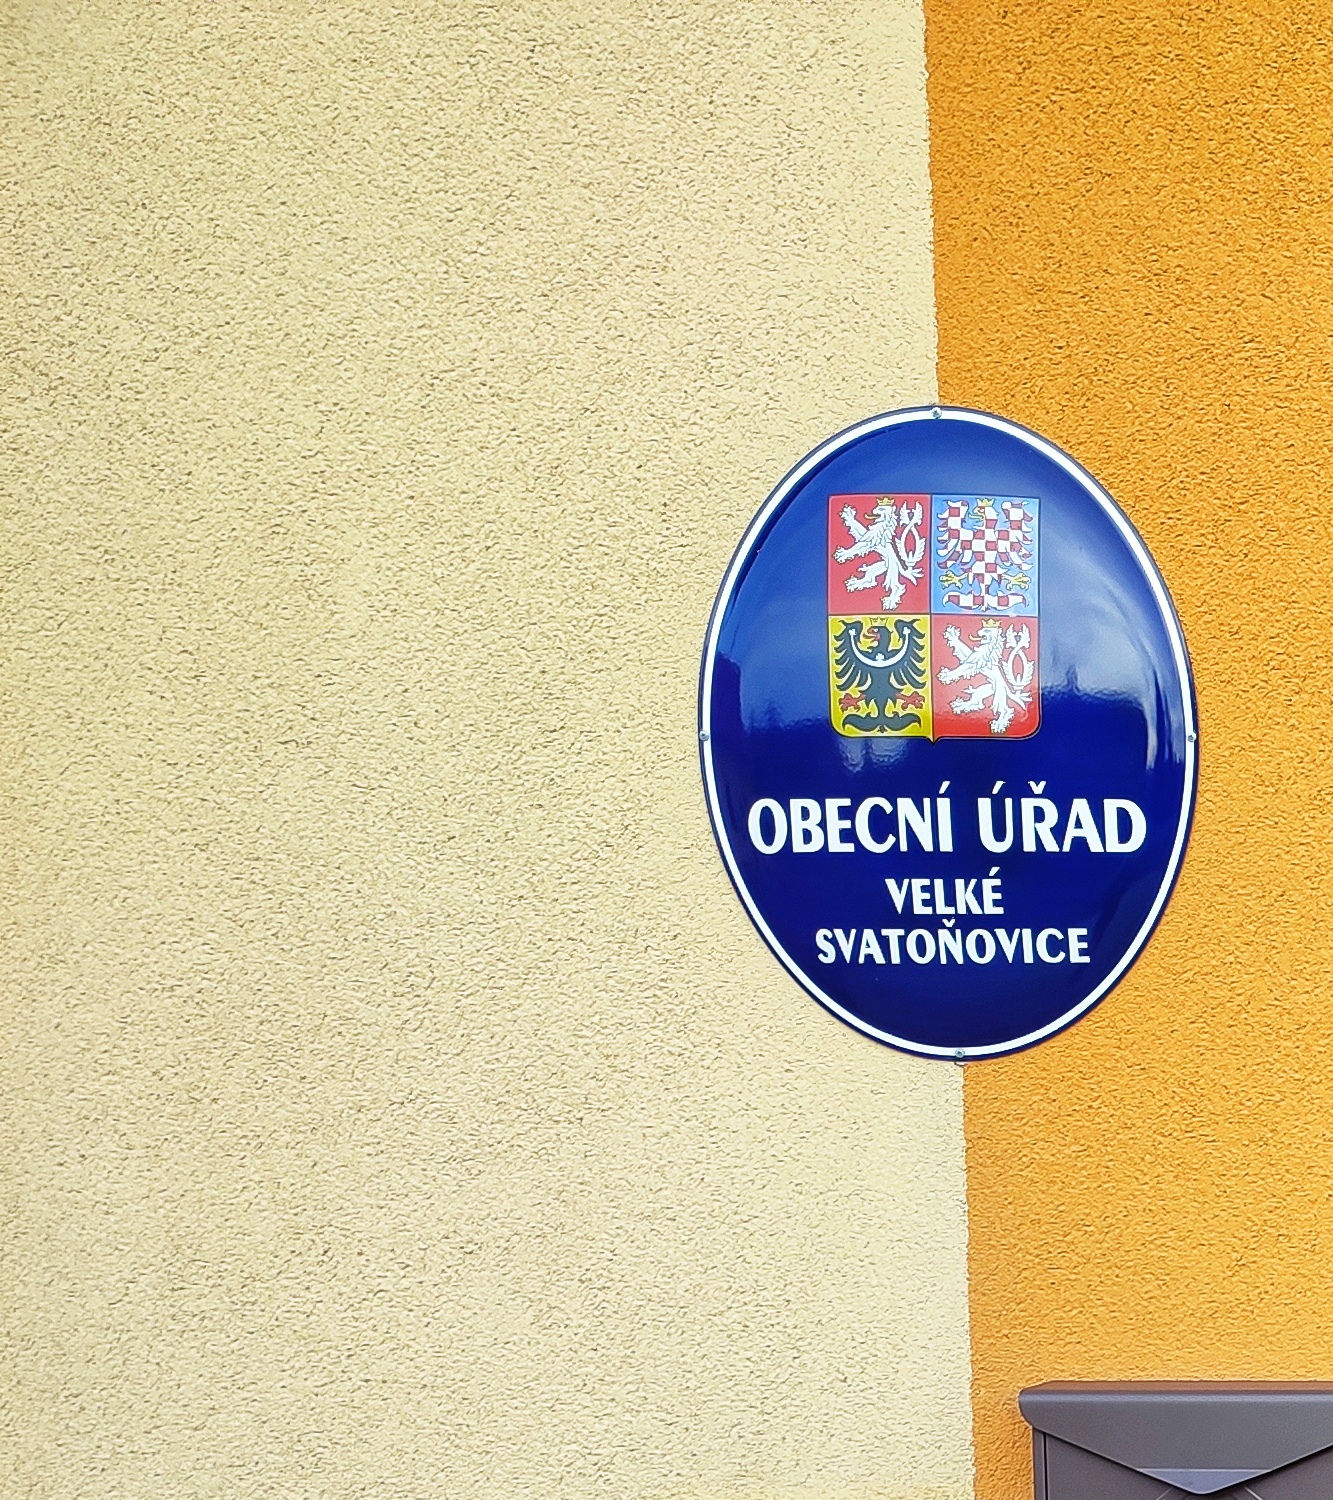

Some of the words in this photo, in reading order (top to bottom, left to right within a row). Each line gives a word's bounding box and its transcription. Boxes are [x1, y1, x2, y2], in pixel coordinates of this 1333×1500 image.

[747, 781, 954, 855] OBECNÍ
[978, 781, 1148, 854] ÚŘAD
[884, 867, 1005, 915] VELKÉ
[816, 918, 1091, 965] SVATOŇOVICE
